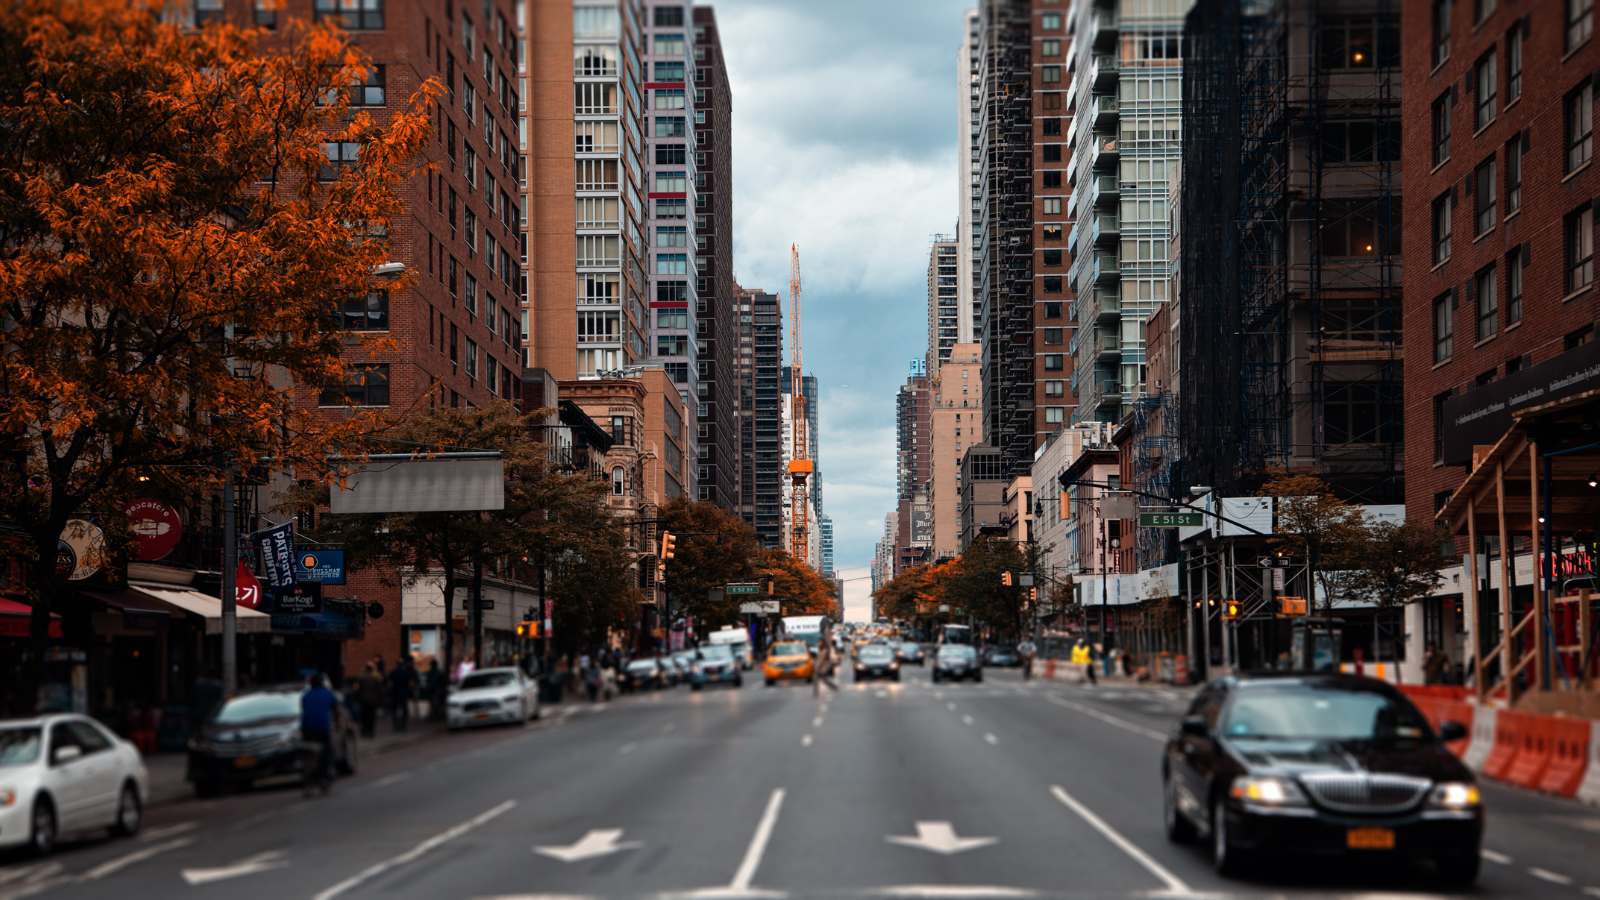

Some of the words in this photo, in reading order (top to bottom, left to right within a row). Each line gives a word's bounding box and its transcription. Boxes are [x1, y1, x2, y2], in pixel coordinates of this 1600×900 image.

[1153, 516, 1159, 524] E
[1163, 516, 1174, 524] 51
[1178, 515, 1190, 524] St
[262, 538, 280, 587] COUNTRY
[273, 531, 293, 586] PATRIOTS
[282, 595, 313, 605] BarKogi
